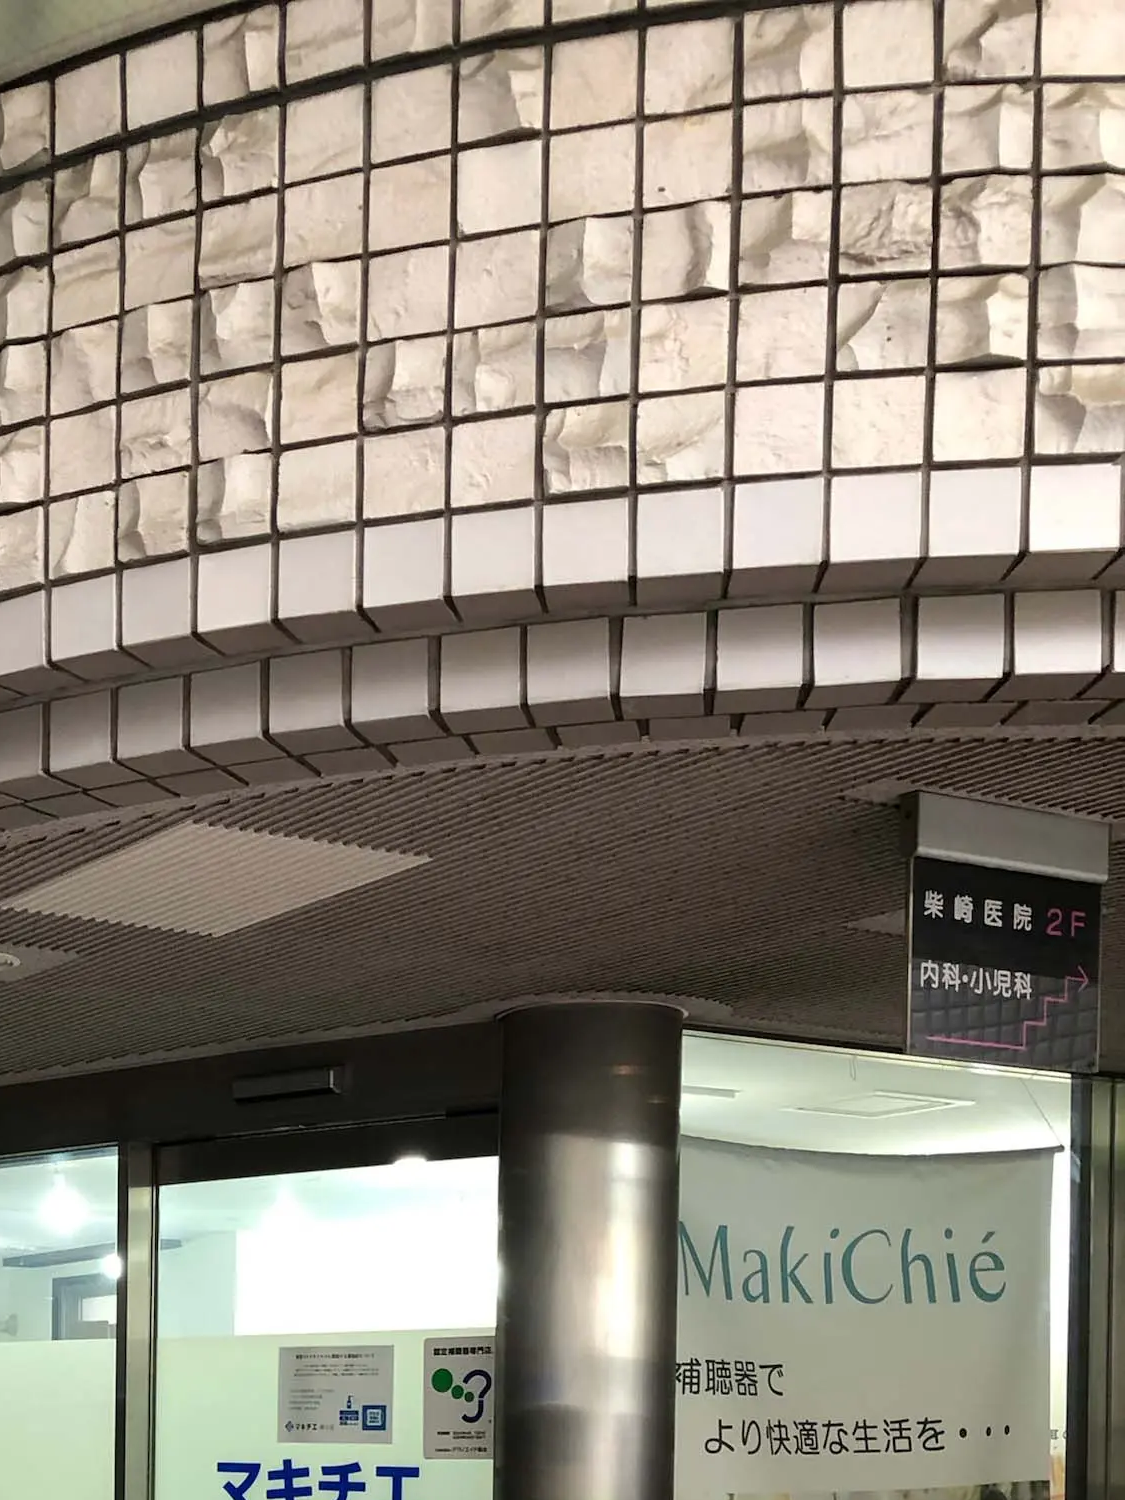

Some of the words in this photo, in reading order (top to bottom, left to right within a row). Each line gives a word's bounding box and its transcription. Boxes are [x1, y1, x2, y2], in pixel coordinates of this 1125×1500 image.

[1045, 907, 1087, 937] 2F
[920, 959, 1032, 1000] 内科・小児科
[678, 1221, 1007, 1304] MakiChié
[675, 1358, 784, 1396] 補聴器で
